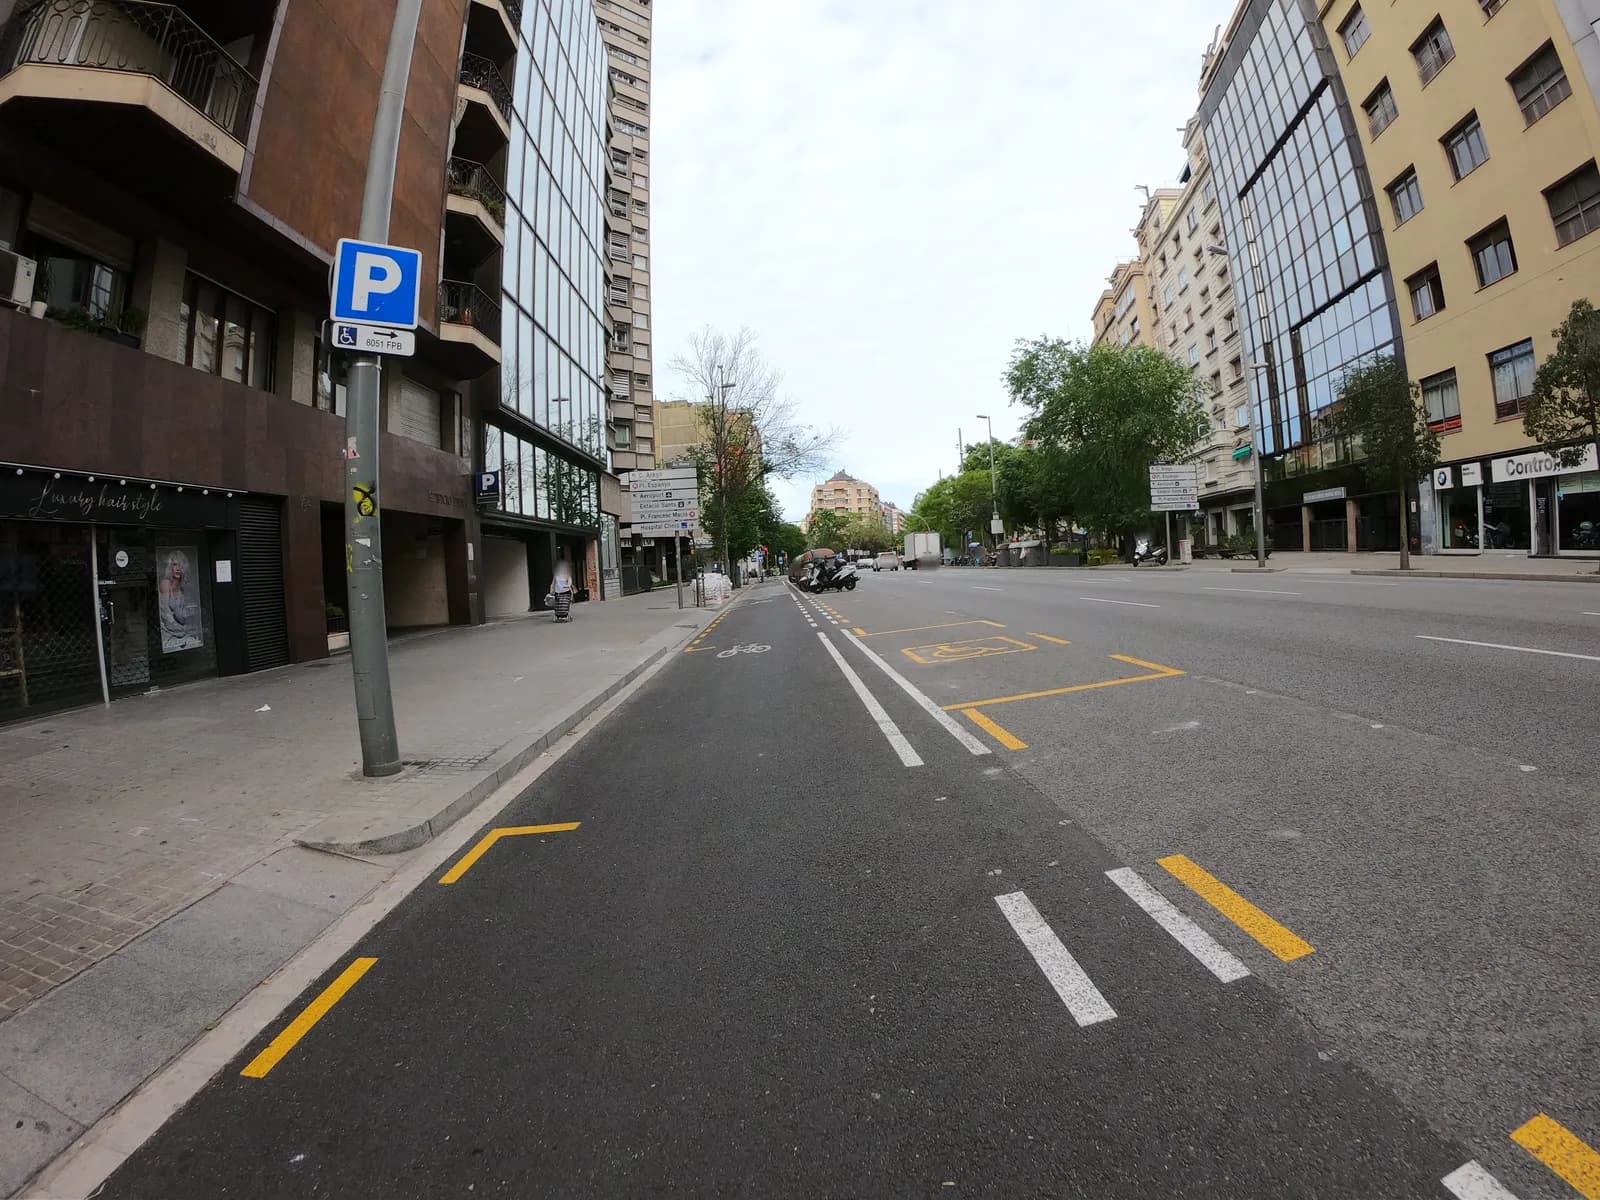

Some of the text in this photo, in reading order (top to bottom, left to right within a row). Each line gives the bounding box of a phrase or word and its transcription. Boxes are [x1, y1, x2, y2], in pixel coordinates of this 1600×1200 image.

[351, 251, 402, 312] P
[366, 338, 402, 351] 8051 FPB
[1506, 455, 1556, 476] Contro
[482, 473, 495, 491] P
[29, 478, 94, 516] Luxury
